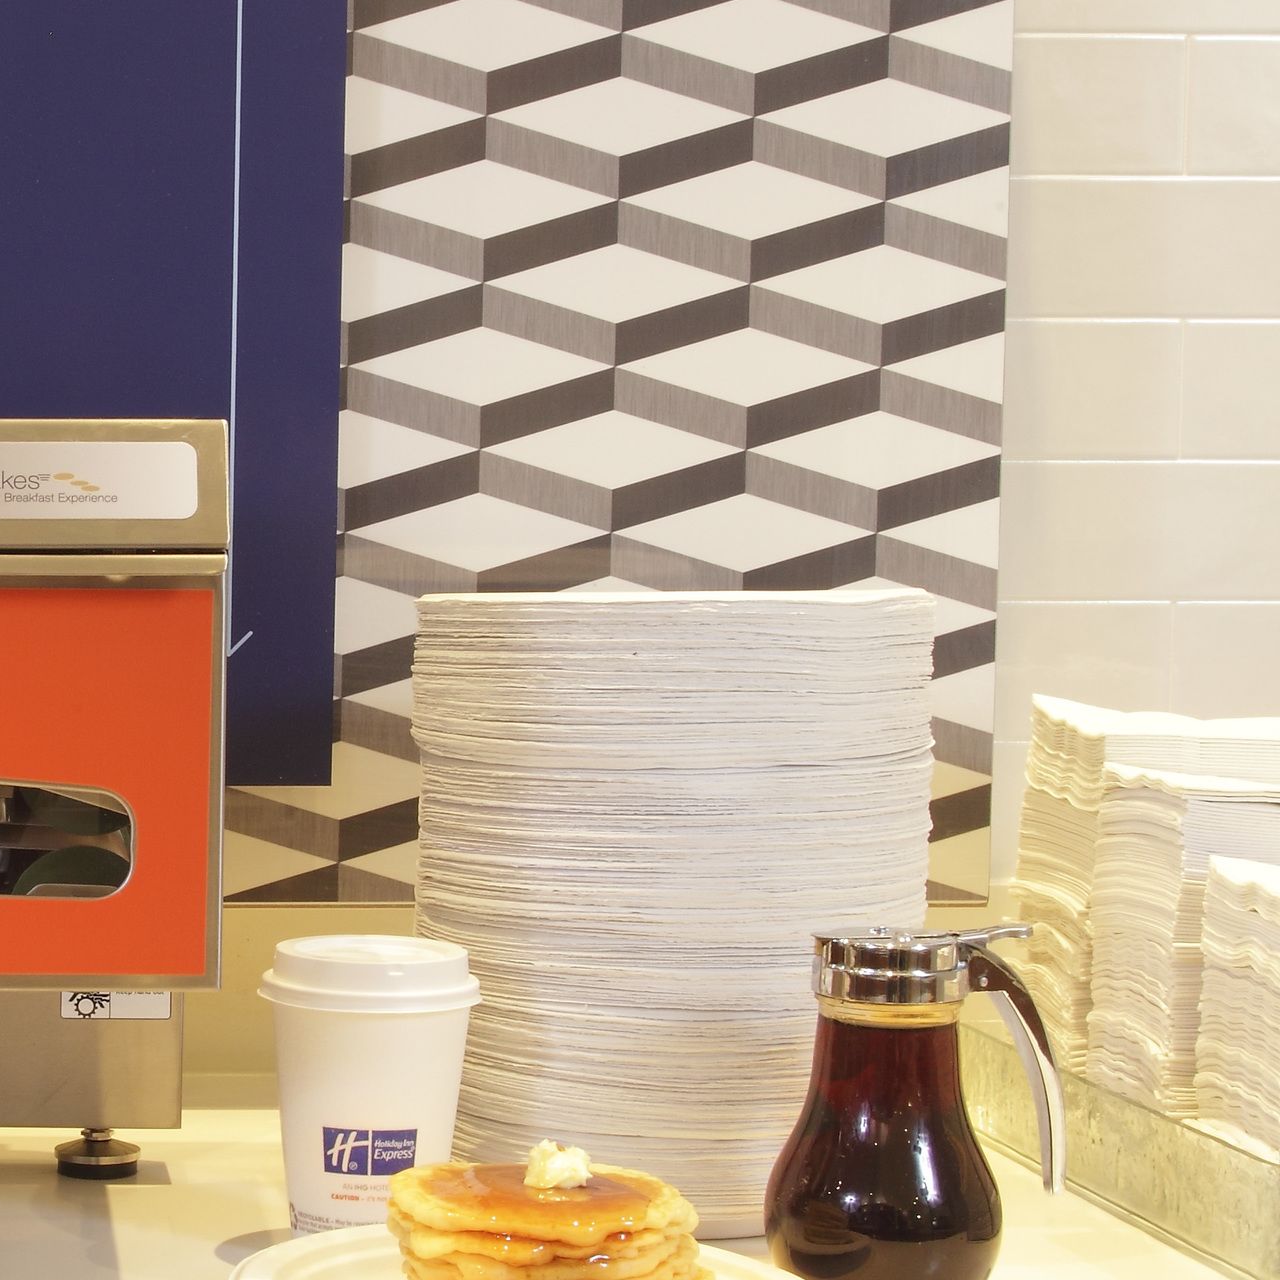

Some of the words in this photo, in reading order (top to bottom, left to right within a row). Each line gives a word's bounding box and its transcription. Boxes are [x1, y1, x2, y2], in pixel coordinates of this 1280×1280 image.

[4, 492, 55, 503] Breakfast
[57, 492, 118, 505] Experience
[374, 1139, 402, 1149] Holiday
[403, 1139, 415, 1147] Inn
[374, 1148, 414, 1162] Express
